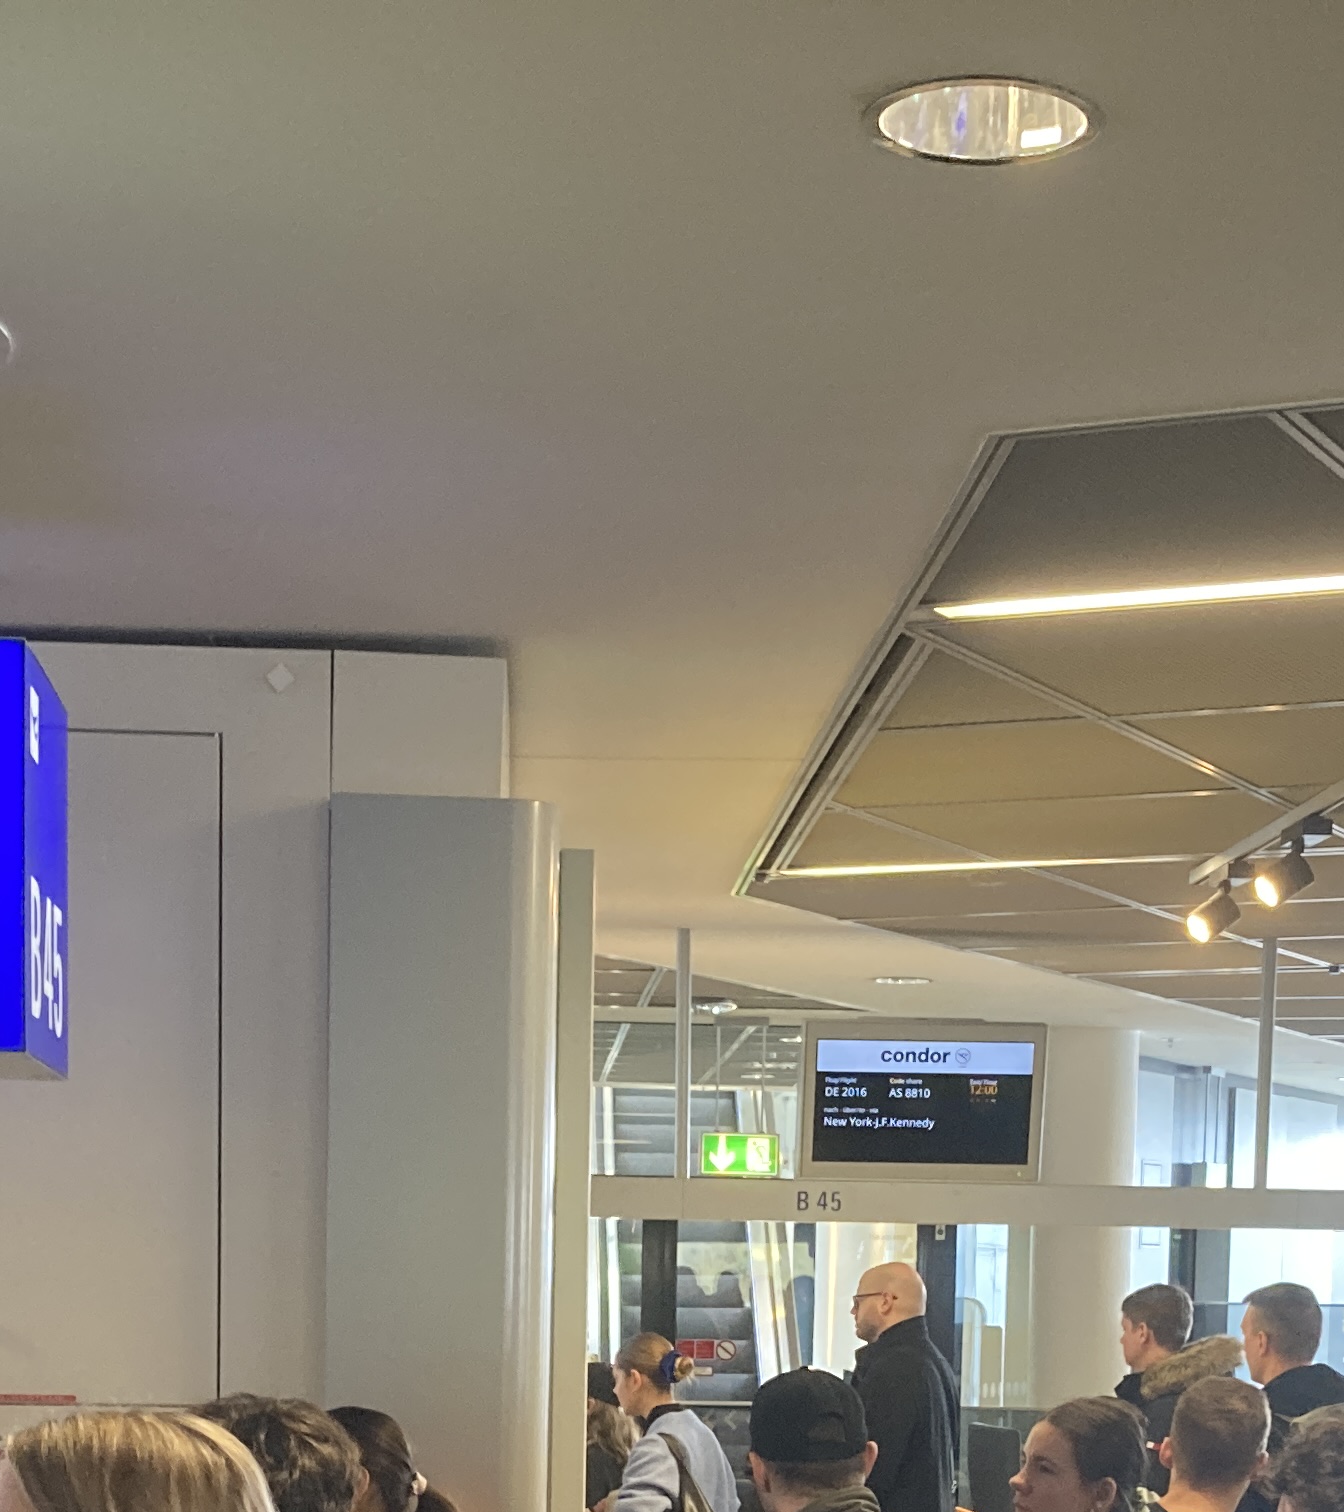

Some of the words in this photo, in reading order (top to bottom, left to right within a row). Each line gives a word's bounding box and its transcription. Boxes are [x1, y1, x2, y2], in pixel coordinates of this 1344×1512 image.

[30, 875, 41, 1019] B
[43, 897, 62, 1038] 45
[881, 1047, 951, 1063] condor
[824, 1087, 840, 1098] DE
[842, 1087, 868, 1098] 2016
[888, 1088, 903, 1098] AS
[905, 1088, 931, 1099] 8810
[823, 1116, 847, 1127] New
[797, 1191, 809, 1212] B
[817, 1191, 841, 1212] 45
